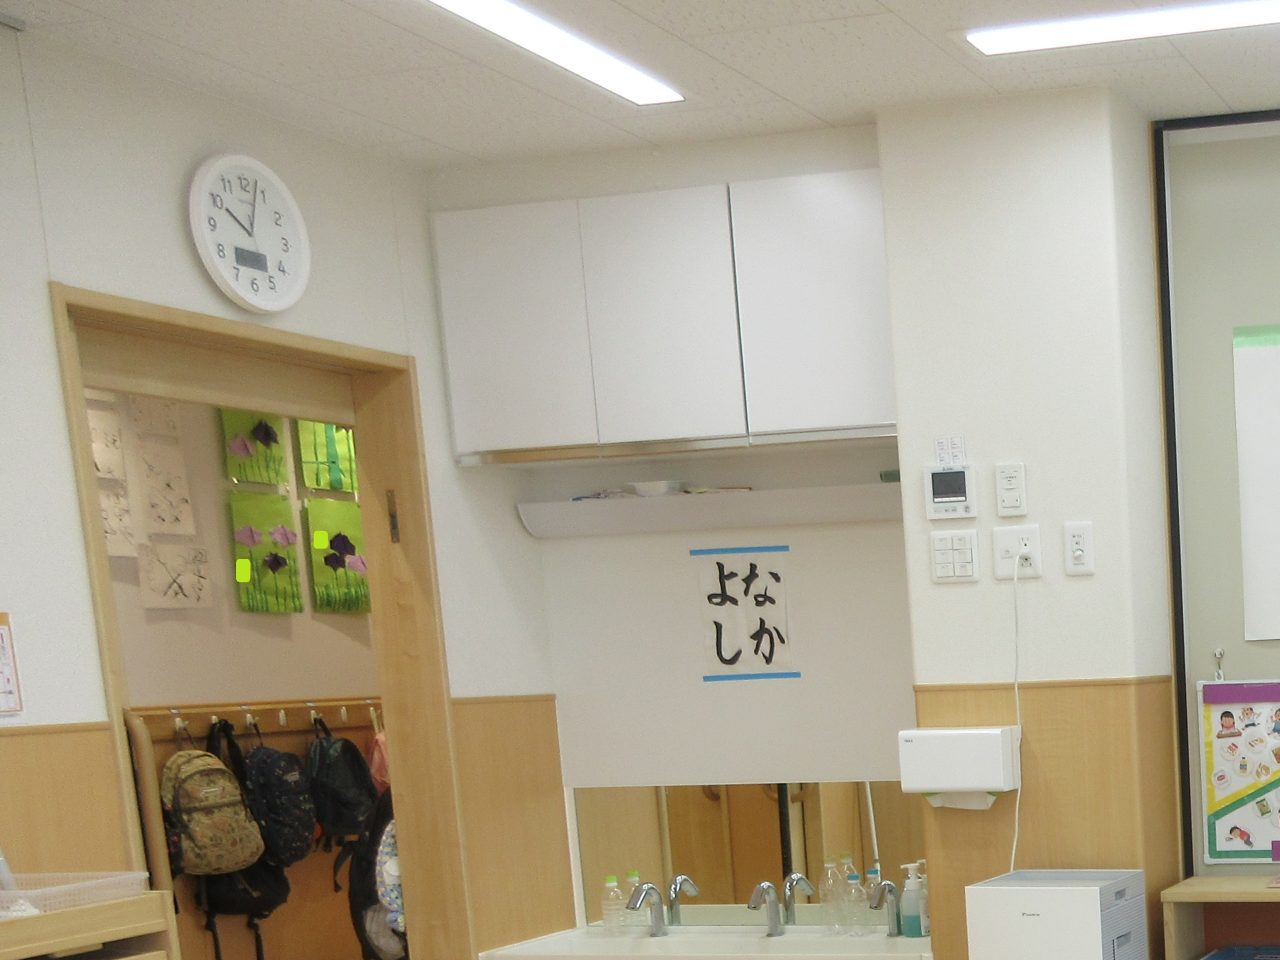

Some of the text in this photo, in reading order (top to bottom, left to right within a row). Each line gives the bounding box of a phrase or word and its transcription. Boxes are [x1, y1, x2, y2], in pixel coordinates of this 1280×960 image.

[221, 175, 232, 194] 11
[238, 175, 250, 193] 12
[209, 192, 223, 209] 10
[260, 190, 266, 203] 1
[208, 216, 217, 232] 9
[274, 211, 282, 226] 2
[217, 243, 225, 258] 8
[281, 237, 289, 252] 3
[233, 267, 240, 281] 7
[278, 260, 286, 274] 4
[251, 278, 259, 292] 6
[268, 276, 276, 290] 5
